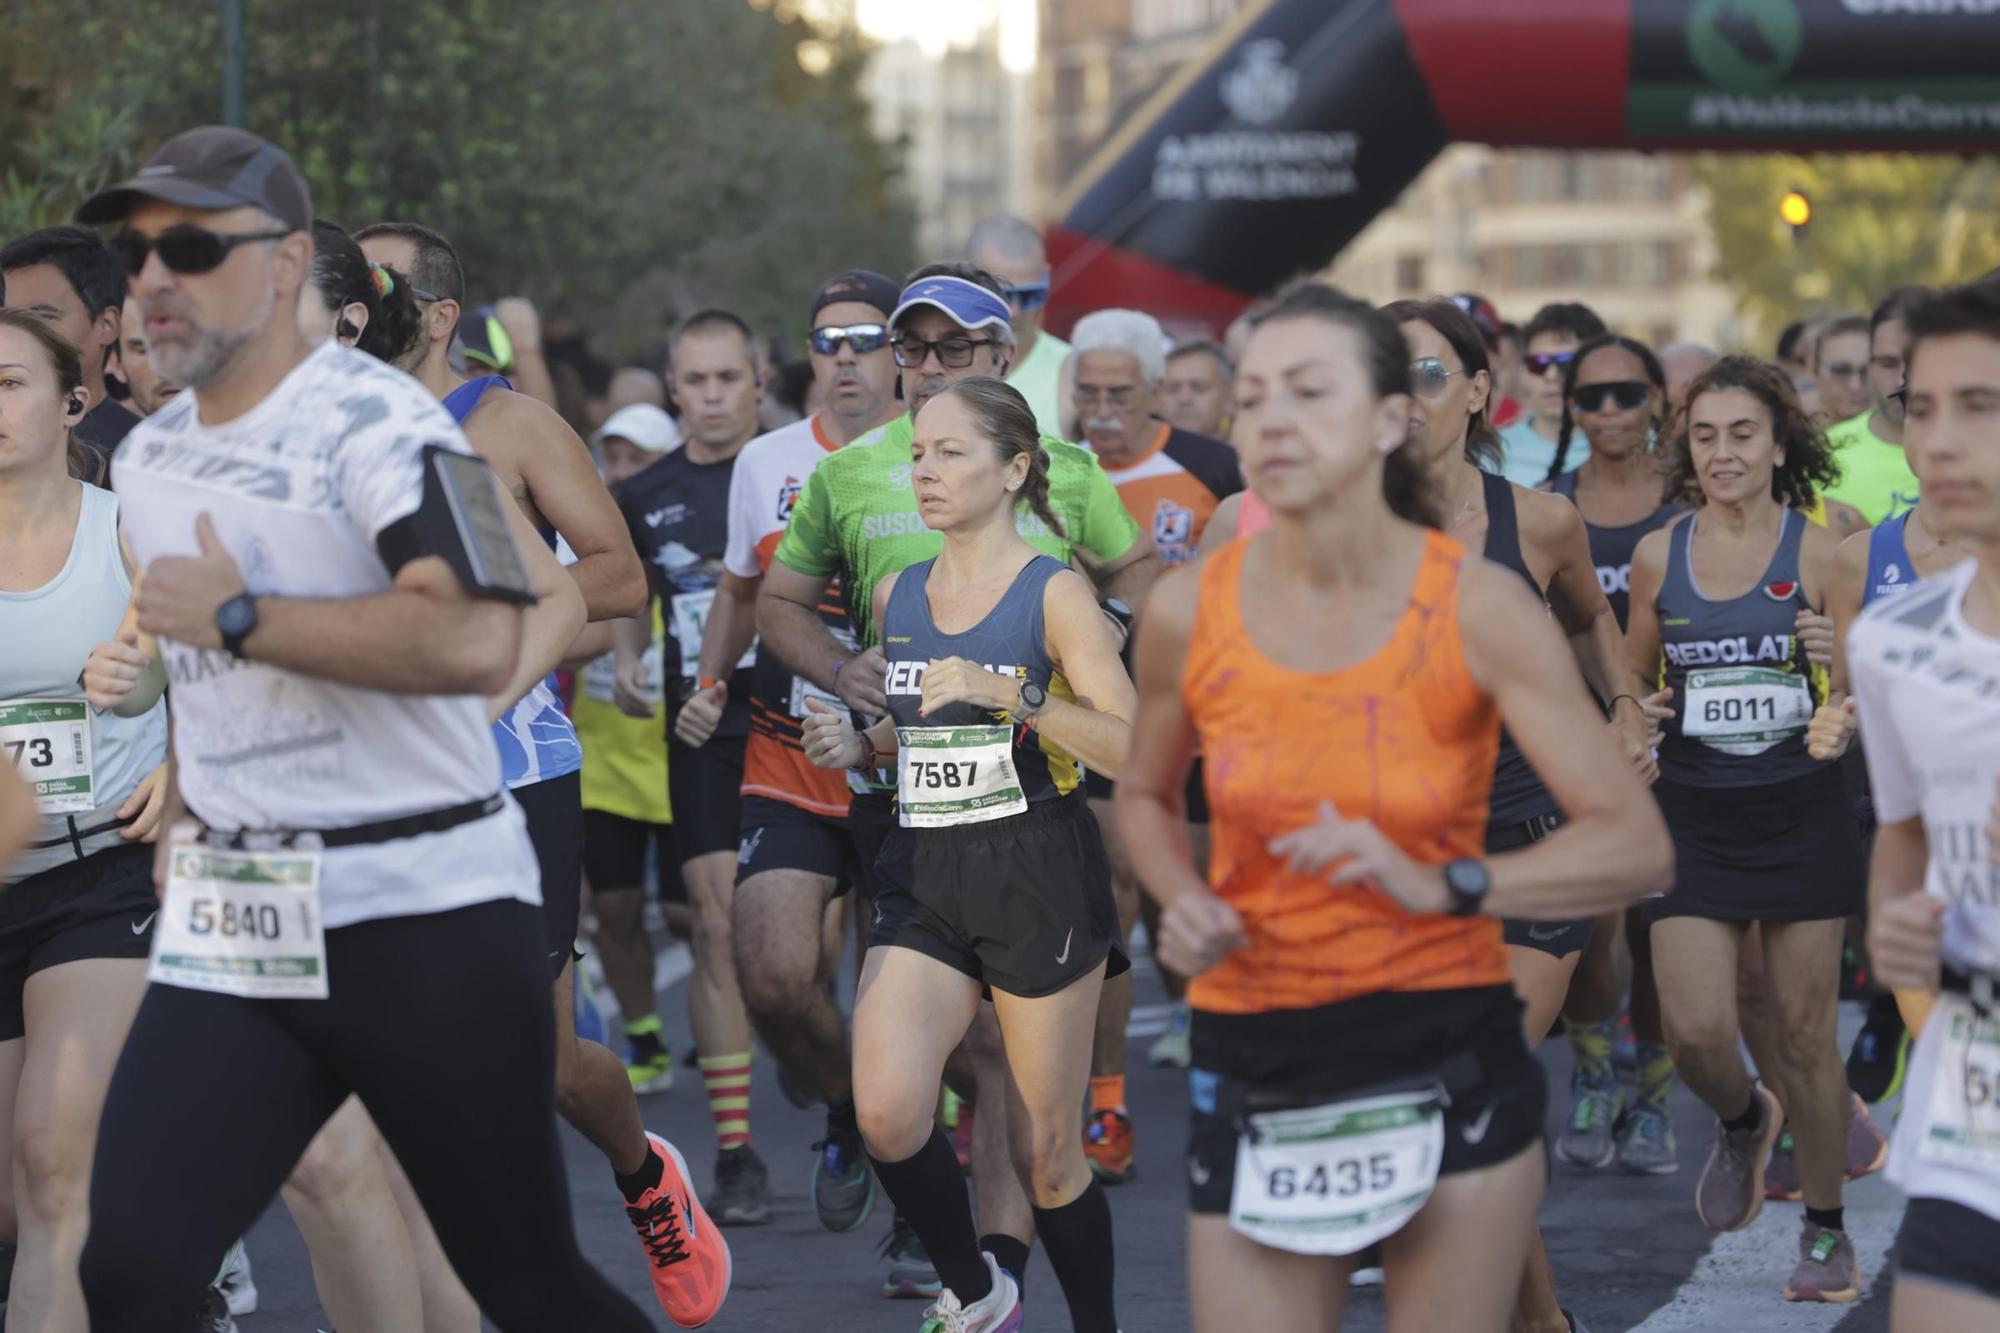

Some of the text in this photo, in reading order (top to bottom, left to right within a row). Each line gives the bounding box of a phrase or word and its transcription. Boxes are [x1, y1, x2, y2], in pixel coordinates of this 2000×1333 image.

[1664, 635, 1789, 666] REDOLAT
[1704, 697, 1775, 722] 6011
[910, 761, 978, 788] 7587
[188, 898, 280, 940] 5840
[1268, 1154, 1395, 1199] 6435
